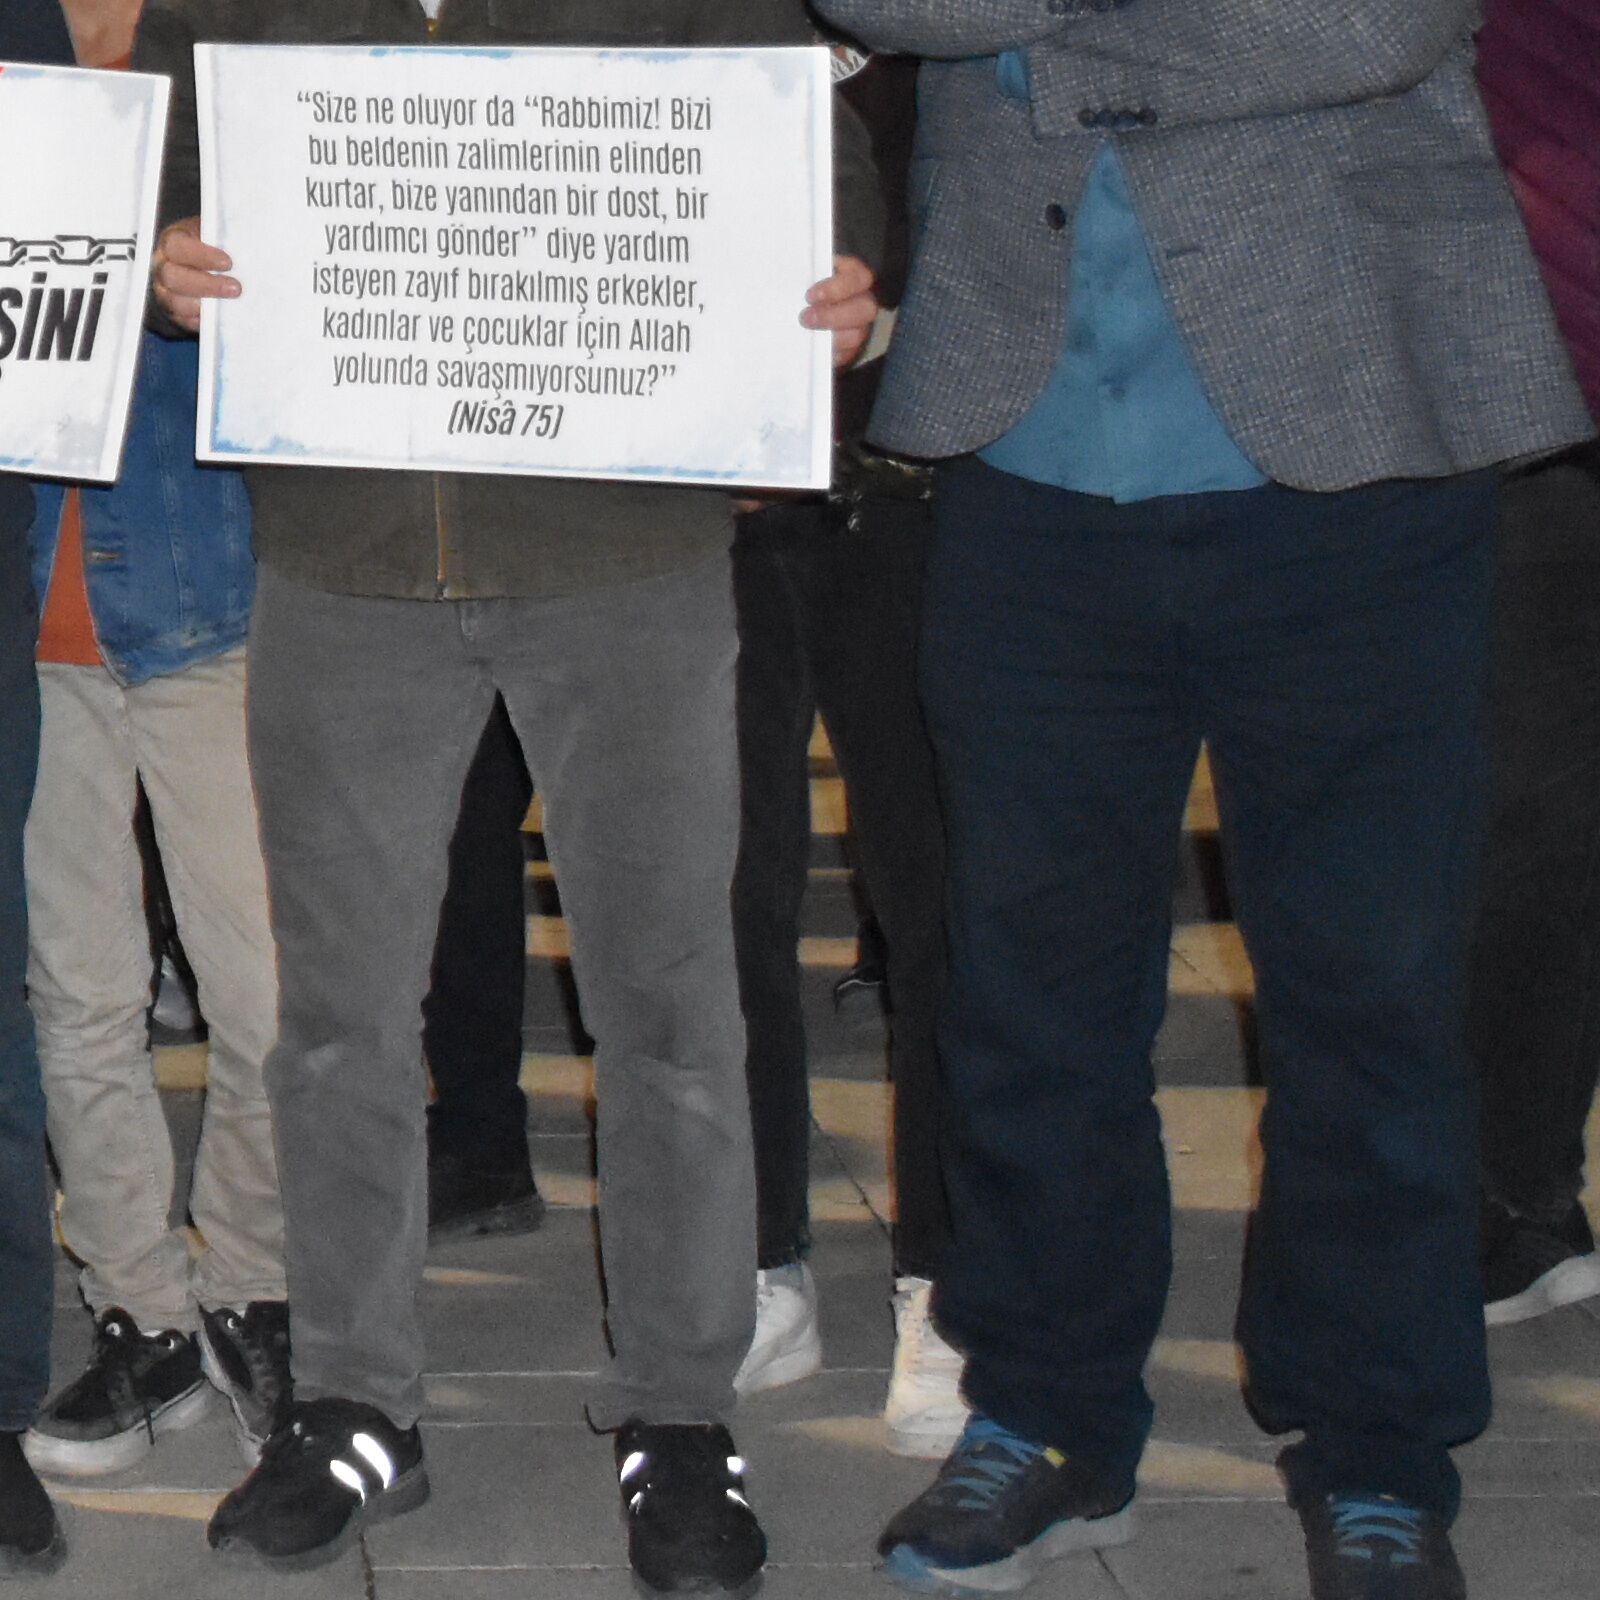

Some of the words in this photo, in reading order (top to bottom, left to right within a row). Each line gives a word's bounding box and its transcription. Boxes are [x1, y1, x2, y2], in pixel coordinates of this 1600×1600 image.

[365, 95, 395, 126] ne
[402, 93, 478, 131] oluyor
[485, 94, 516, 128] da
[670, 96, 712, 131] Bizi
[308, 134, 338, 167] bu
[345, 134, 449, 169] beldenin
[456, 137, 601, 174] zalimlerinin
[609, 140, 702, 176] elinden
[305, 176, 385, 215] kurtar,
[391, 177, 438, 212] bize
[445, 182, 558, 216] yanından
[566, 184, 599, 217] bir
[607, 186, 668, 225] dost,
[676, 186, 709, 220] bir
[324, 220, 428, 256] yardımcı
[546, 226, 596, 264] diye
[603, 229, 691, 265] yardım
[312, 261, 397, 300] isteyen
[404, 266, 460, 303] zayıf
[467, 266, 589, 315] bırakılmış
[596, 273, 705, 315] erkekler,
[321, 306, 422, 343] kadınlar
[428, 314, 454, 344] ve
[462, 313, 569, 355] çocuklar
[576, 315, 621, 360] için
[628, 317, 692, 353] Allah
[332, 352, 428, 387] yolunda
